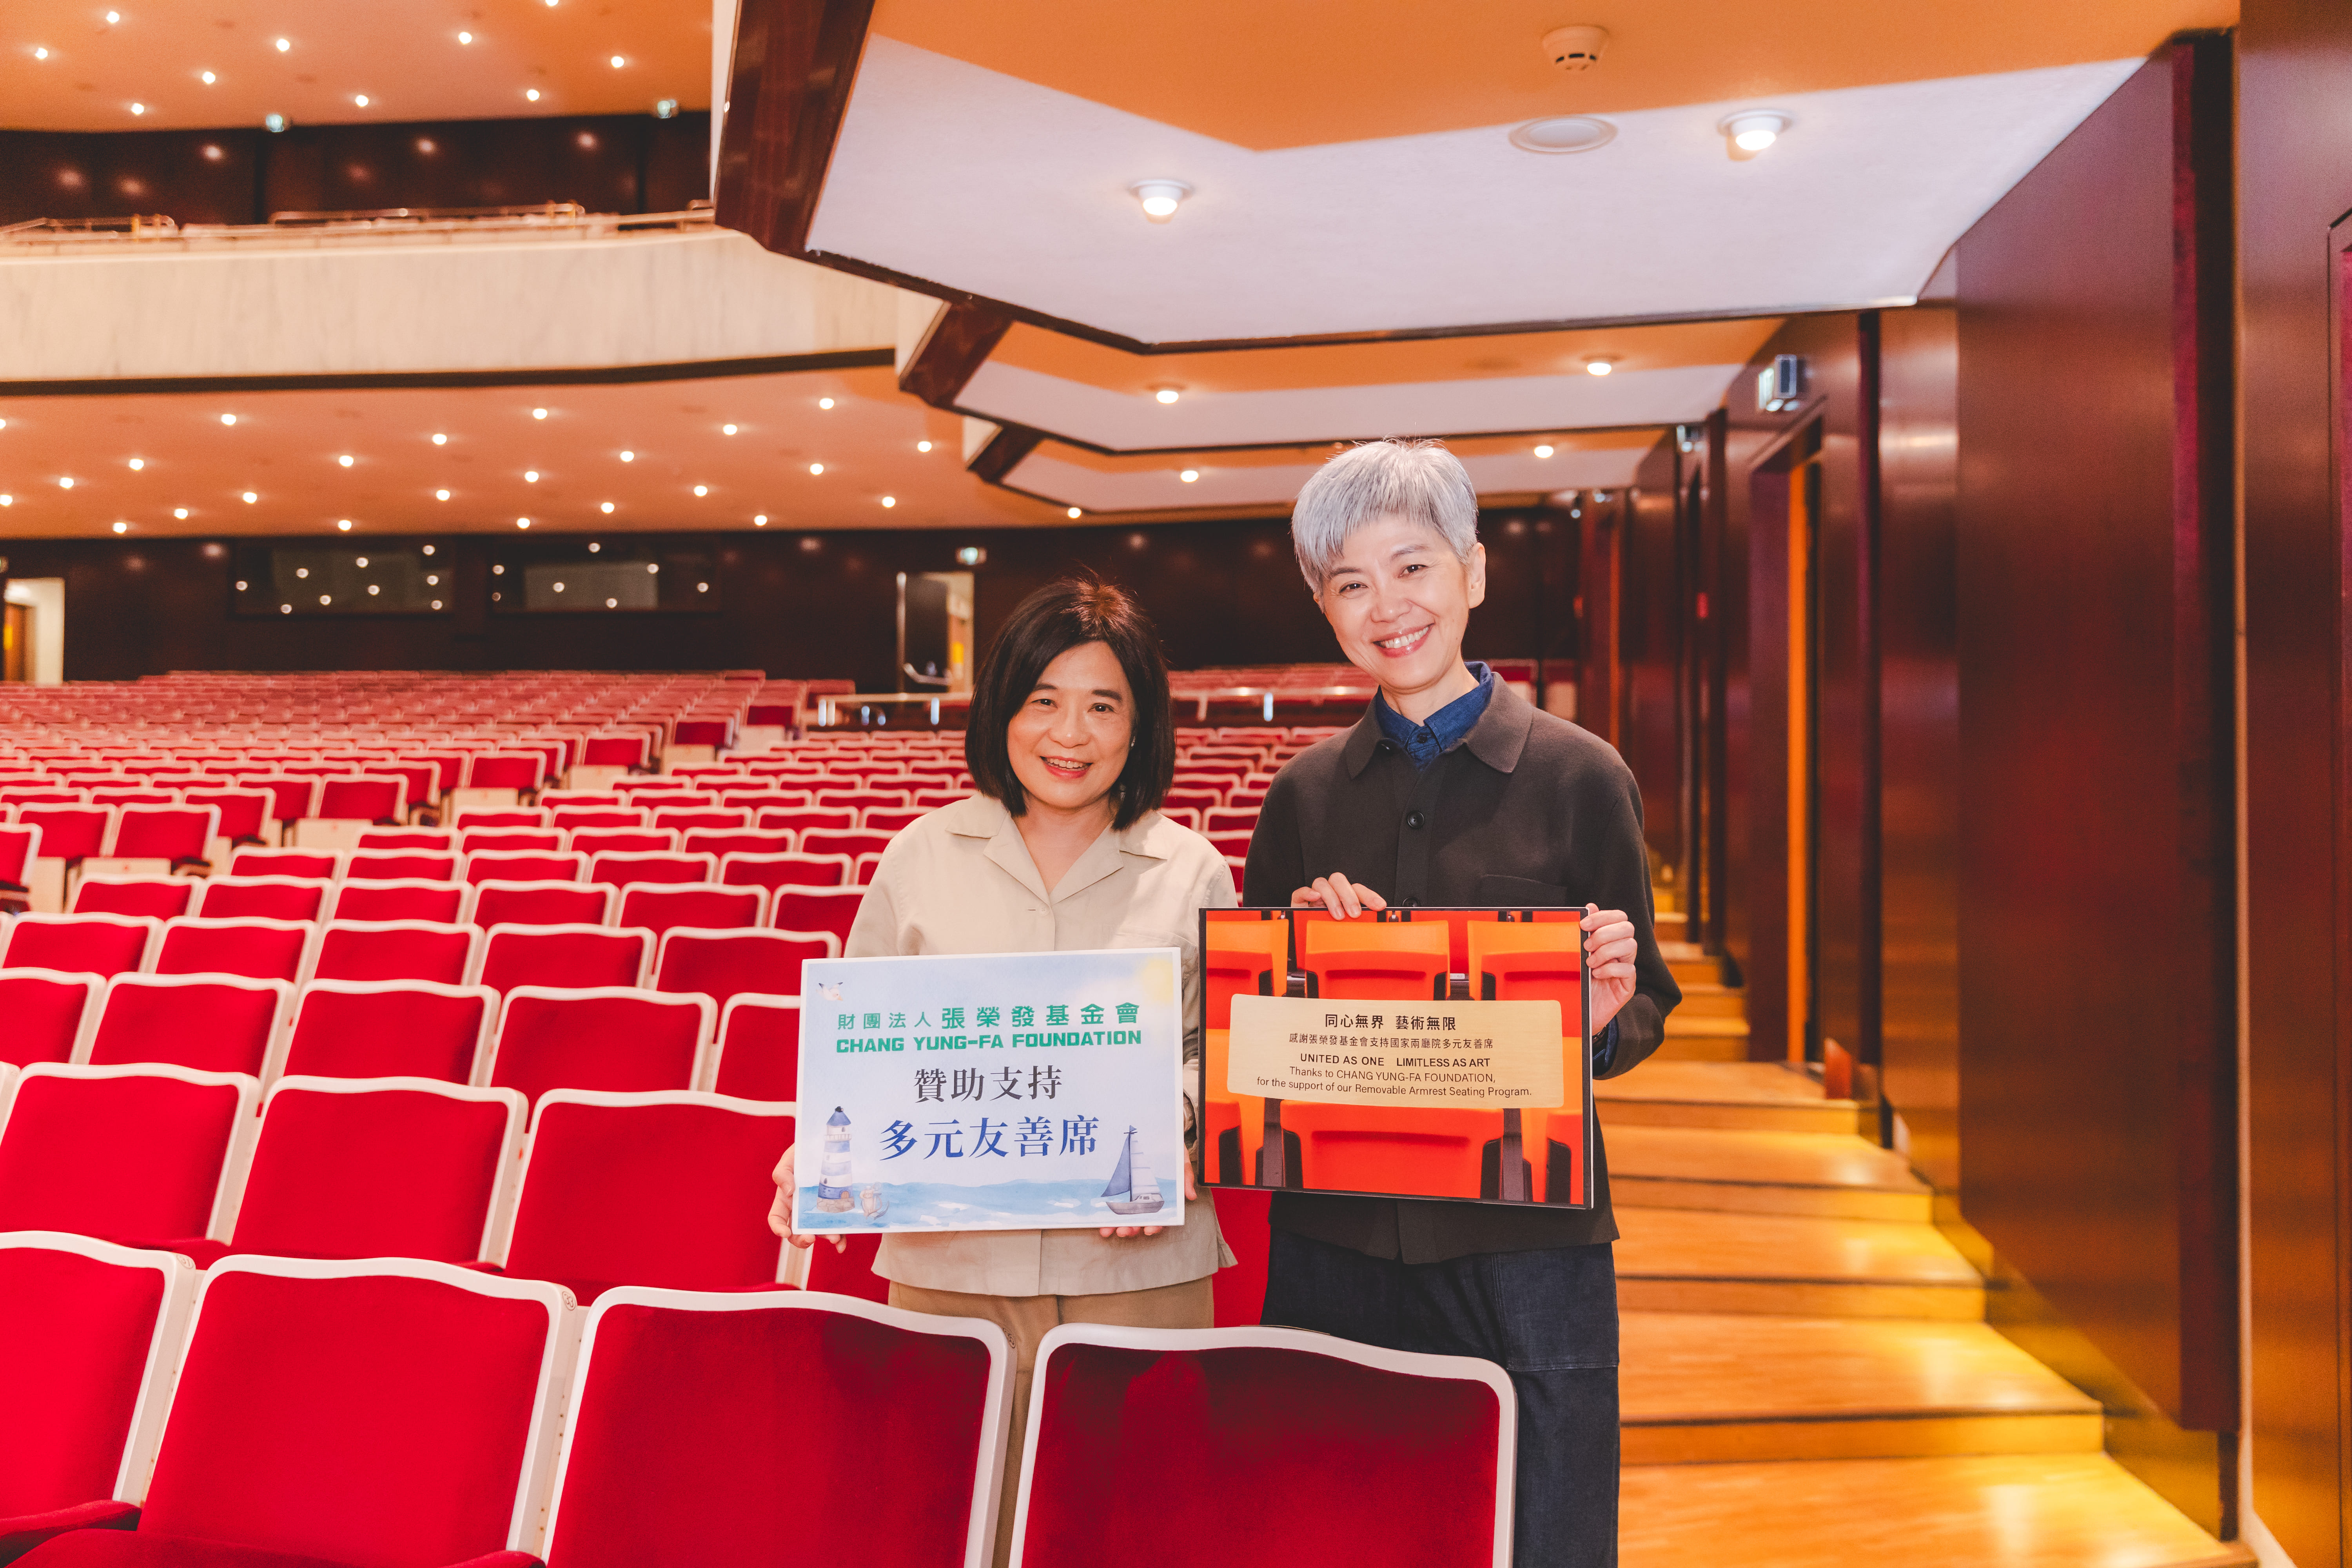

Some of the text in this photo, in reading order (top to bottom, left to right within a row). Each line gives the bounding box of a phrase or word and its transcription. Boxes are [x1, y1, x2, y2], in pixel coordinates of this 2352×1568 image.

[838, 1002, 1141, 1033] 財團法人張榮發基金會
[1325, 1014, 1456, 1031] 同心無界 藝術無限
[837, 1031, 1141, 1053] CHANG YUNG-FA FOUNDATION
[1289, 1033, 1494, 1049] 感謝張榮發基金會支持國家兩廳院多元友善席
[1301, 1053, 1490, 1067] UNITED AS ONE LIMITLESS AS ART
[914, 1065, 1062, 1103] 贊助支持
[1289, 1066, 1495, 1083] Thanks to CHANG YUNG-FA FOUNDATION,
[1257, 1076, 1270, 1085] for
[1272, 1078, 1286, 1087] the
[1289, 1082, 1323, 1091] support
[1325, 1082, 1335, 1091] of
[1355, 1084, 1406, 1094] Removable
[1409, 1086, 1446, 1095] Armrest
[1450, 1087, 1485, 1098] Seating
[1488, 1087, 1532, 1098] Program.
[880, 1114, 1099, 1161] 多元友善席
[564, 1294, 573, 1308] 33
